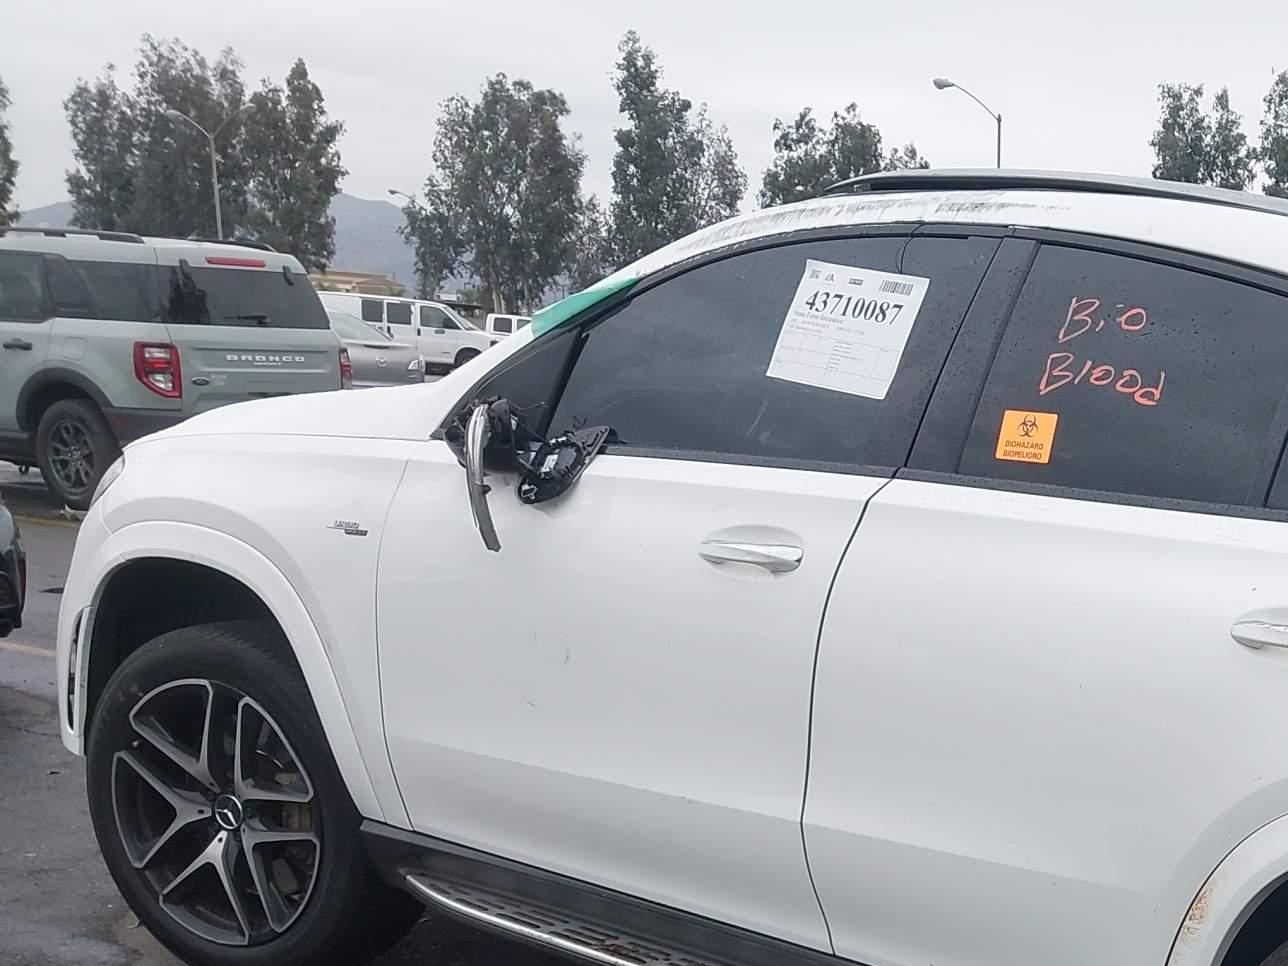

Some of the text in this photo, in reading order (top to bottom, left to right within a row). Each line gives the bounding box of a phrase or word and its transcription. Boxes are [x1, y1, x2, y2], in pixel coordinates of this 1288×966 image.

[805, 290, 904, 325] 43710087
[1058, 296, 1148, 344] Bio
[225, 354, 306, 363] BRONCO
[1039, 352, 1167, 407] Blood
[1002, 450, 1043, 460] BIOPELIGRO
[1004, 440, 1044, 450] BIOHAZARD
